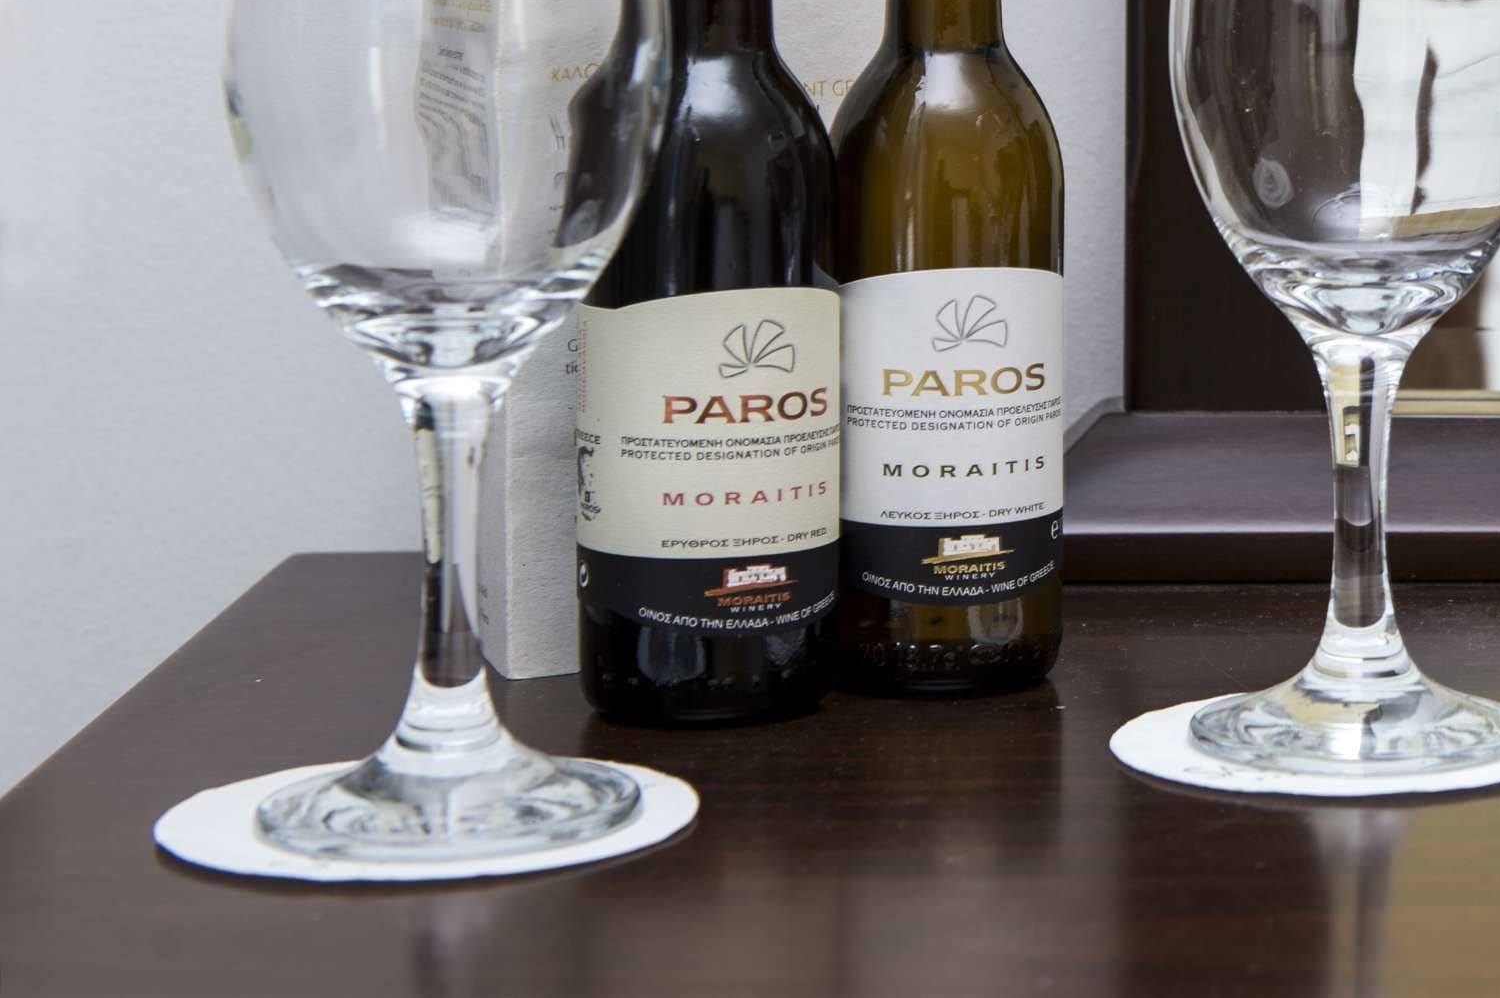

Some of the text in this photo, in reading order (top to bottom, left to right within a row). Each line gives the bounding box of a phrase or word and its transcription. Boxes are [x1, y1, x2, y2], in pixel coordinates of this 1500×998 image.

[881, 363, 1045, 397] PAROS
[662, 387, 828, 425] PAROS
[847, 404, 936, 419] ΠΡΟΣΤΑΤΕΥΟΜΕΝΗ
[939, 408, 994, 419] ΟΝΟΜΑΣΙΑ
[847, 416, 907, 431] PROTECTED
[911, 420, 993, 431] DESIGNATION
[997, 417, 1011, 428] OF
[1014, 413, 1044, 426] ORIGIN
[621, 435, 723, 449] ΠΡΟΣΤΑΤΕΥΟΜΕΝΗ
[725, 436, 781, 447] ΟΝΟΜΑΣΙΑ
[620, 449, 692, 461] PROTECTED
[696, 448, 780, 461] DESIGNATION
[784, 446, 798, 456] OF
[882, 456, 1045, 478] MORAITIS
[662, 481, 827, 506] MORAITIS
[880, 510, 931, 520] ΛΕΥΚΟΣ
[934, 510, 980, 520] ΞΗΡΟΣ
[988, 508, 1012, 518] DRY
[1013, 502, 1044, 515] WHITE
[661, 538, 729, 548] ΕΡΥΘΡΟΣ
[733, 535, 779, 547] ΞΗΡΟΣ
[787, 530, 809, 542] DRY
[810, 527, 827, 537] RED
[933, 561, 1006, 575] MORAITIS
[944, 571, 996, 581] WINERY
[862, 572, 892, 589] ΟΙΝΟΣ
[892, 580, 915, 593] ΑΠΟ
[918, 585, 942, 596] ΤΗΝ
[942, 587, 984, 597] ΕΛΛΑΔΑ
[991, 581, 1016, 593] WINE
[1017, 577, 1029, 587] OF
[1029, 560, 1056, 584] GREECE
[717, 591, 792, 607] MORAITIS
[730, 603, 782, 613] WINERY
[638, 607, 672, 623] ΟΙΝΟΣ
[672, 615, 698, 628] ΑΠΟ
[700, 618, 723, 629] ΤΗΝ
[725, 618, 769, 629] ΕΛΛΑΔΑ
[776, 612, 800, 625] WINE
[800, 607, 812, 618] OF
[812, 590, 837, 614] GREECE
